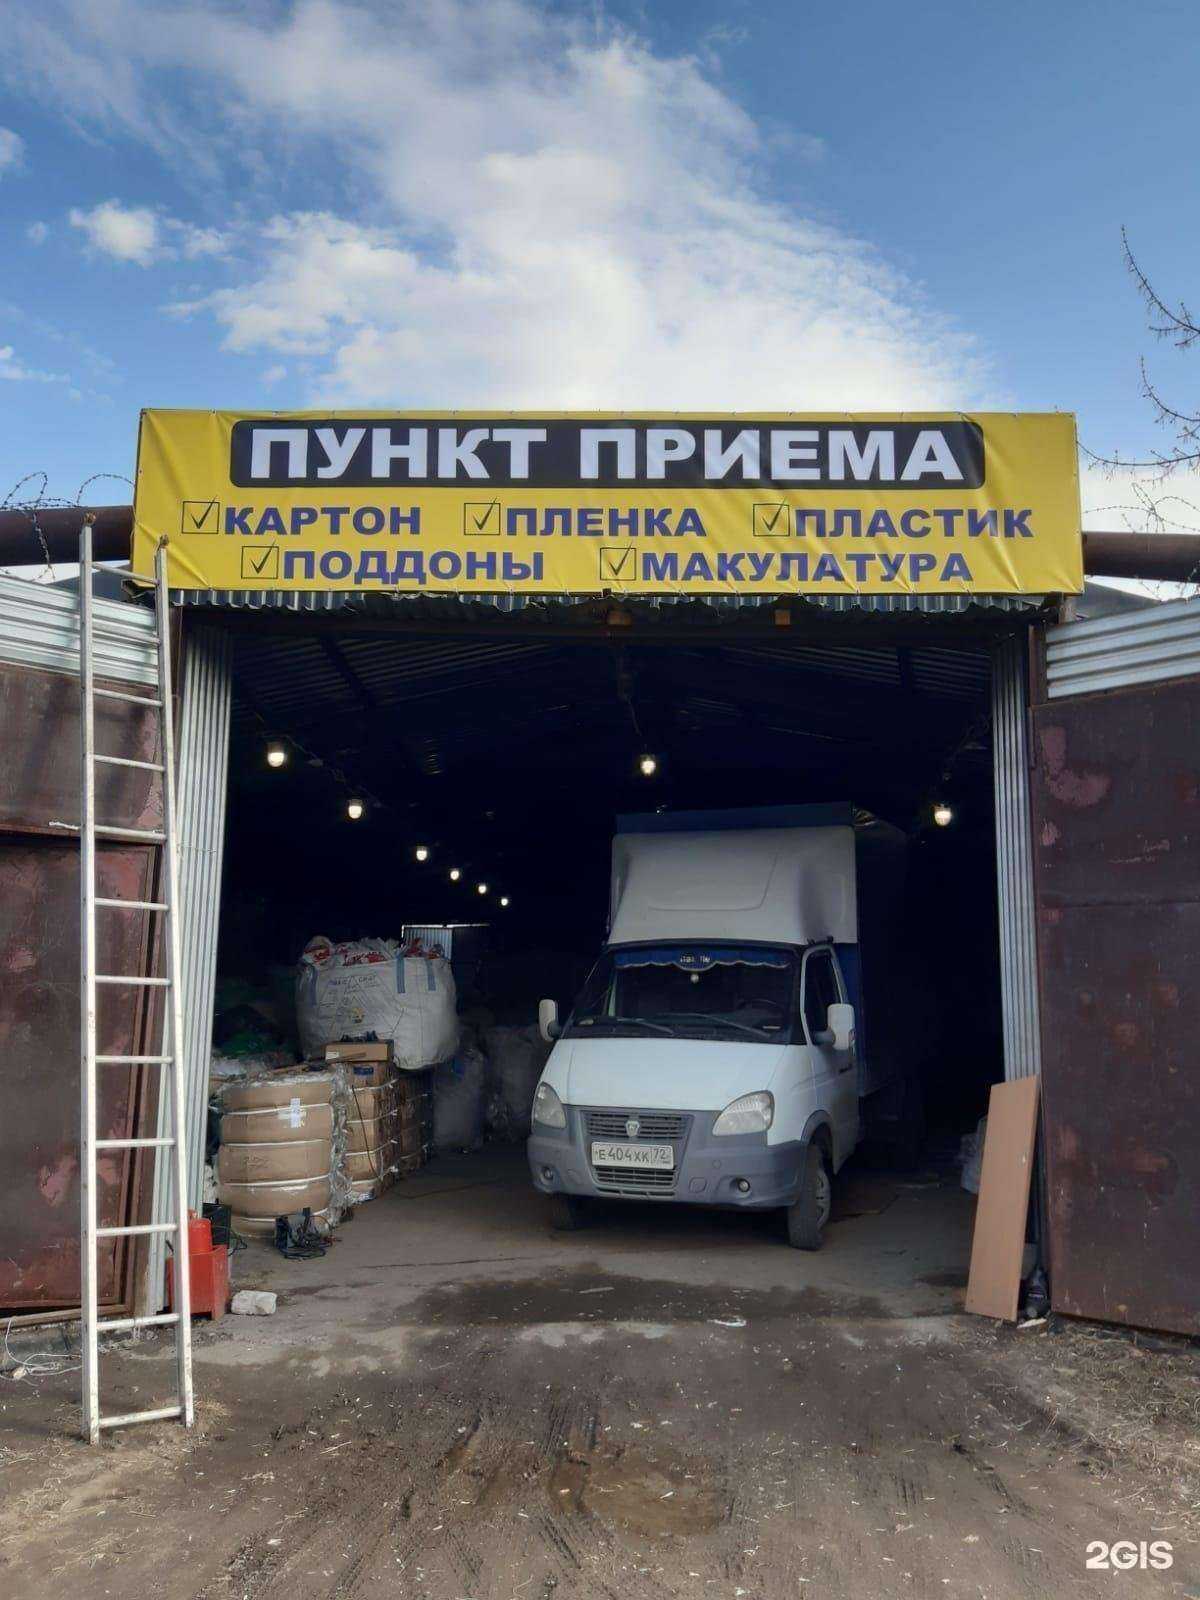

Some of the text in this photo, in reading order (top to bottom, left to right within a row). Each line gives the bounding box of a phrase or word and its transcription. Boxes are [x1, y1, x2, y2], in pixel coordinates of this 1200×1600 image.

[250, 427, 965, 481] ПУНКТ ПРИЕМА
[225, 507, 1034, 537] КАРТОН ПЛЕНКА ПЛАСТИК
[284, 550, 972, 585] ПОДДОНЫ МАКУЛАТУРА
